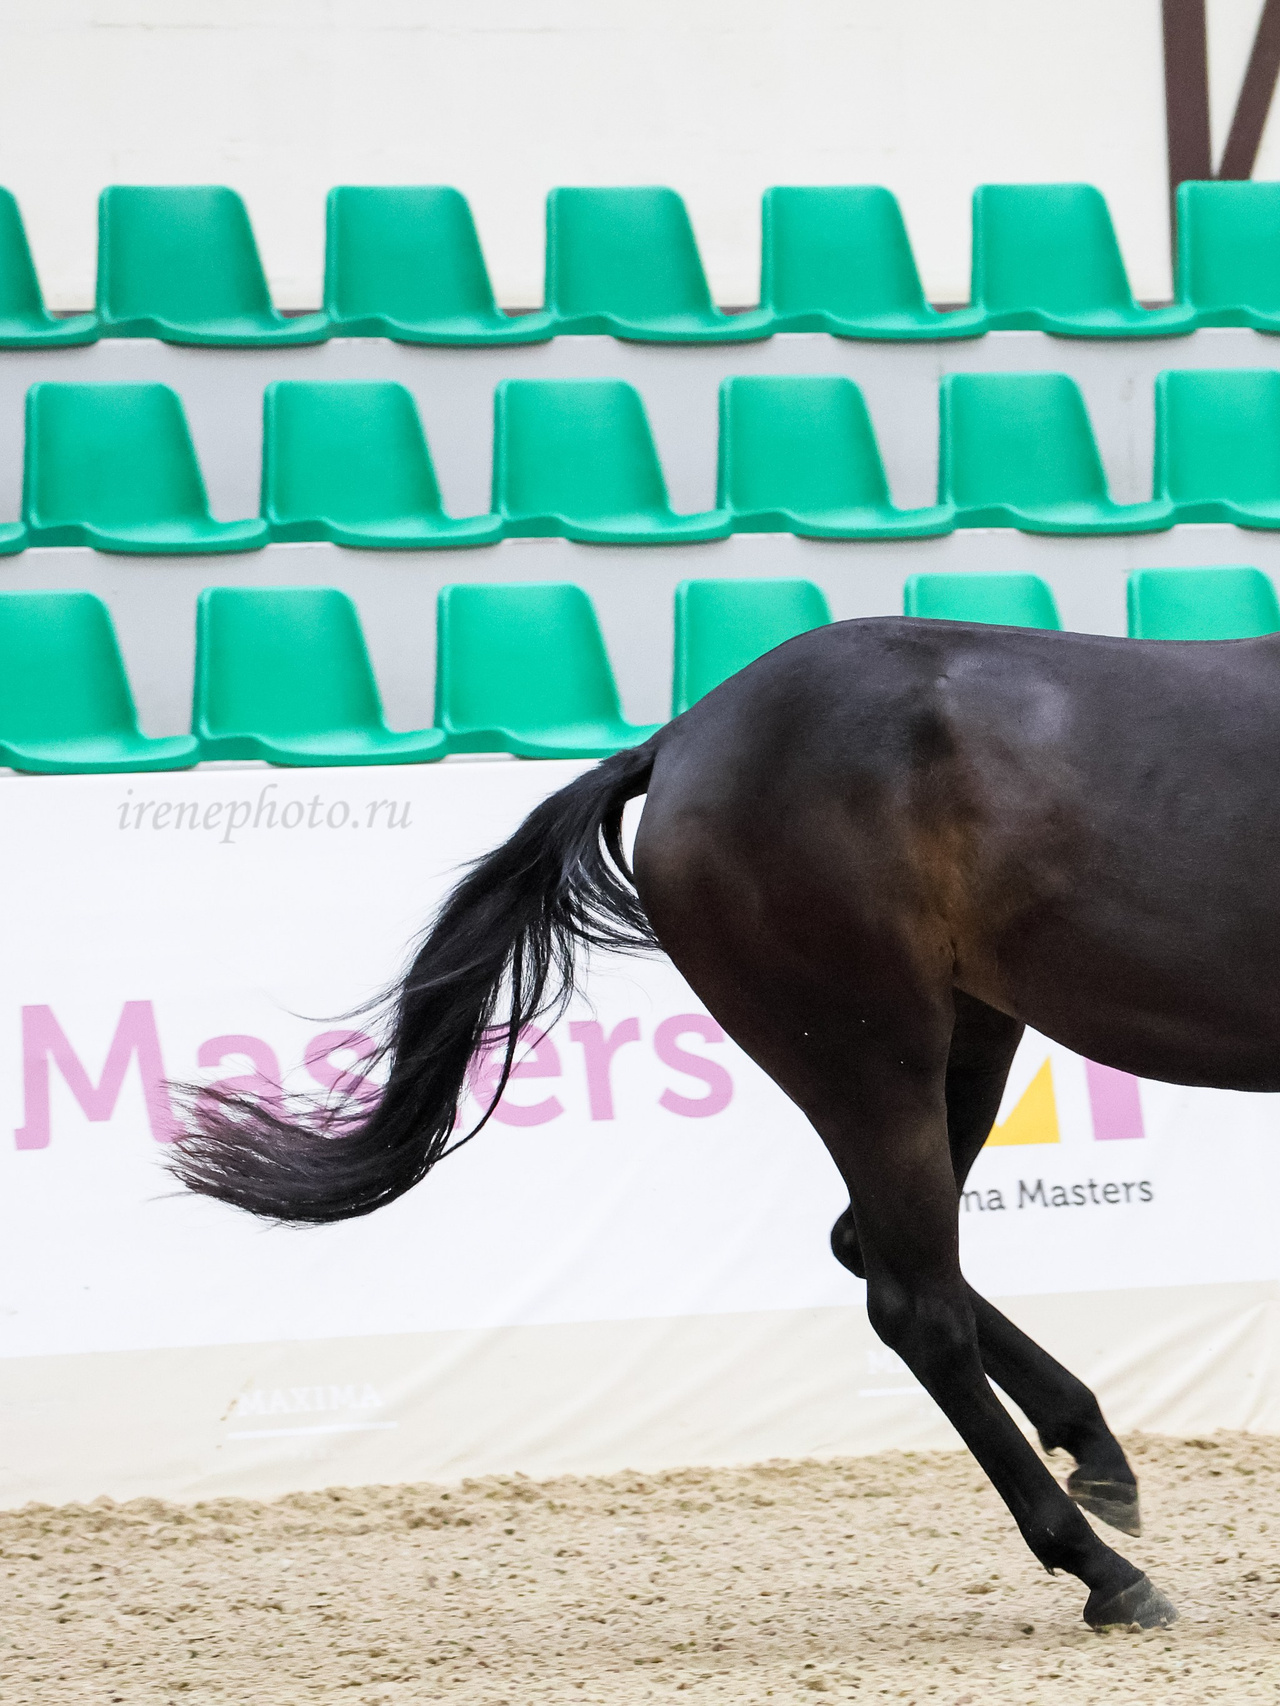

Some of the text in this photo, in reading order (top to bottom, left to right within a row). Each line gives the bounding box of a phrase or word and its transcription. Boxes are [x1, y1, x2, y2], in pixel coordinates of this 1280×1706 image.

[14, 999, 734, 1151] Masers
[1018, 1177, 1154, 1209] Masters
[236, 1383, 383, 1418] MAXIMA
